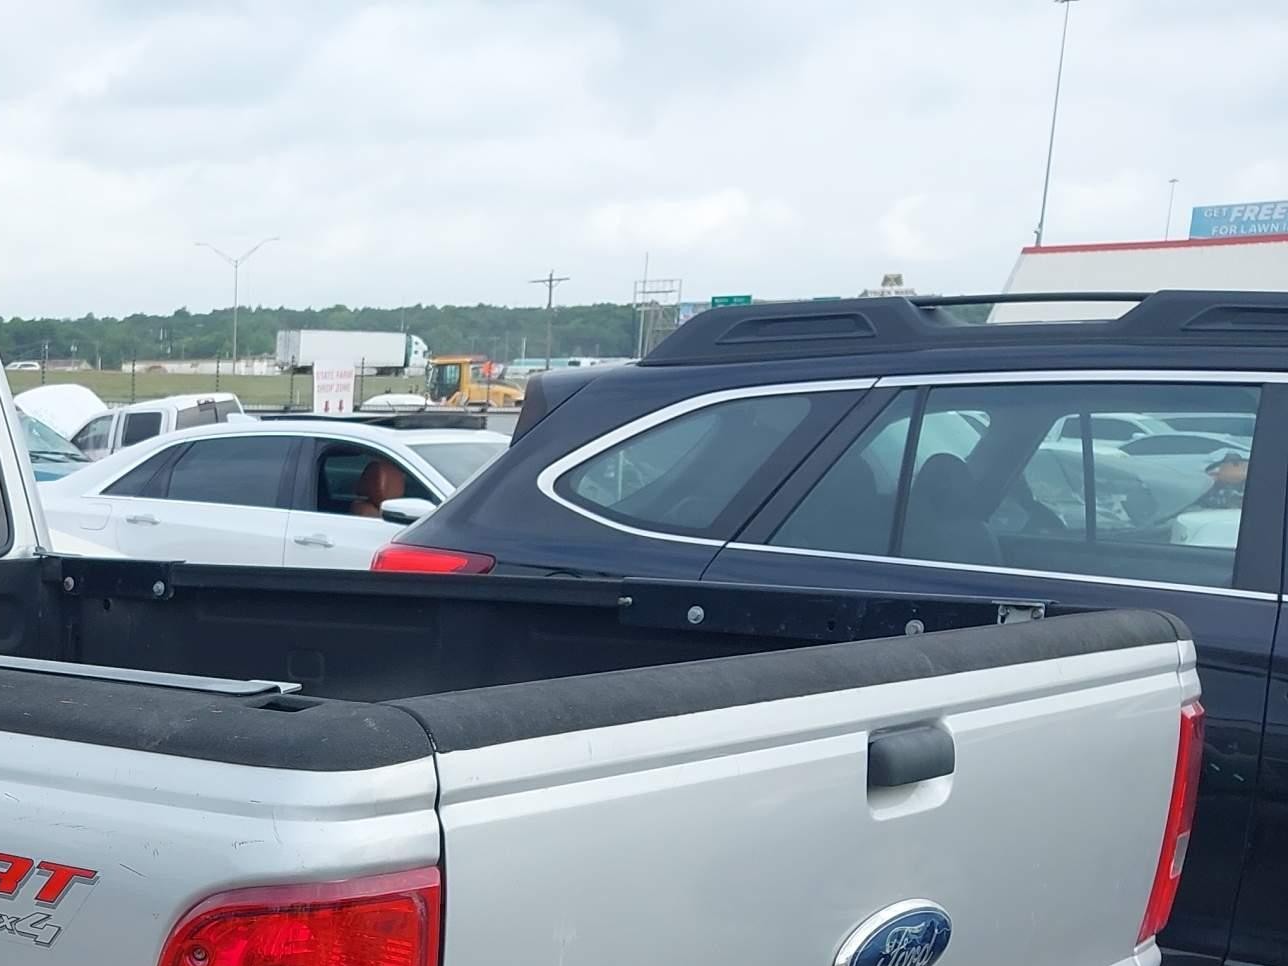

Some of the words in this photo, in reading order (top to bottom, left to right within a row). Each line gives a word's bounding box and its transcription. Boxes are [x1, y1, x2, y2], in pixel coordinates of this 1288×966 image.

[1204, 207, 1228, 217] GET
[1212, 224, 1238, 236] FOR
[1240, 223, 1279, 234] LAWN
